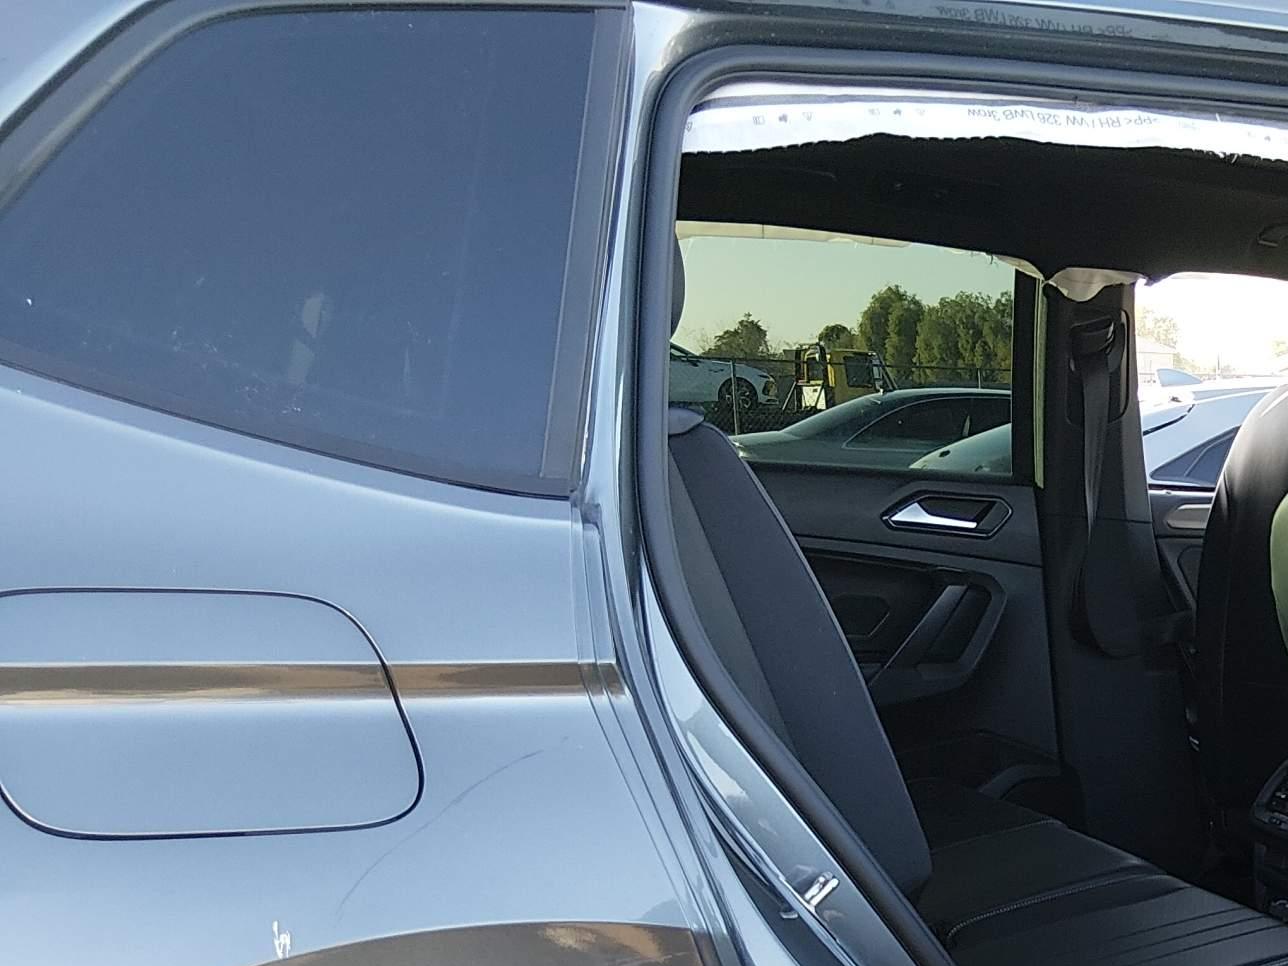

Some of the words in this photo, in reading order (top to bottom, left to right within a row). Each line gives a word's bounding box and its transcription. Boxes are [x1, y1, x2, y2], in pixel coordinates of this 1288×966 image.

[1002, 108, 1035, 122] LWB
[1037, 112, 1062, 126] 326
[1099, 115, 1121, 128] RH
